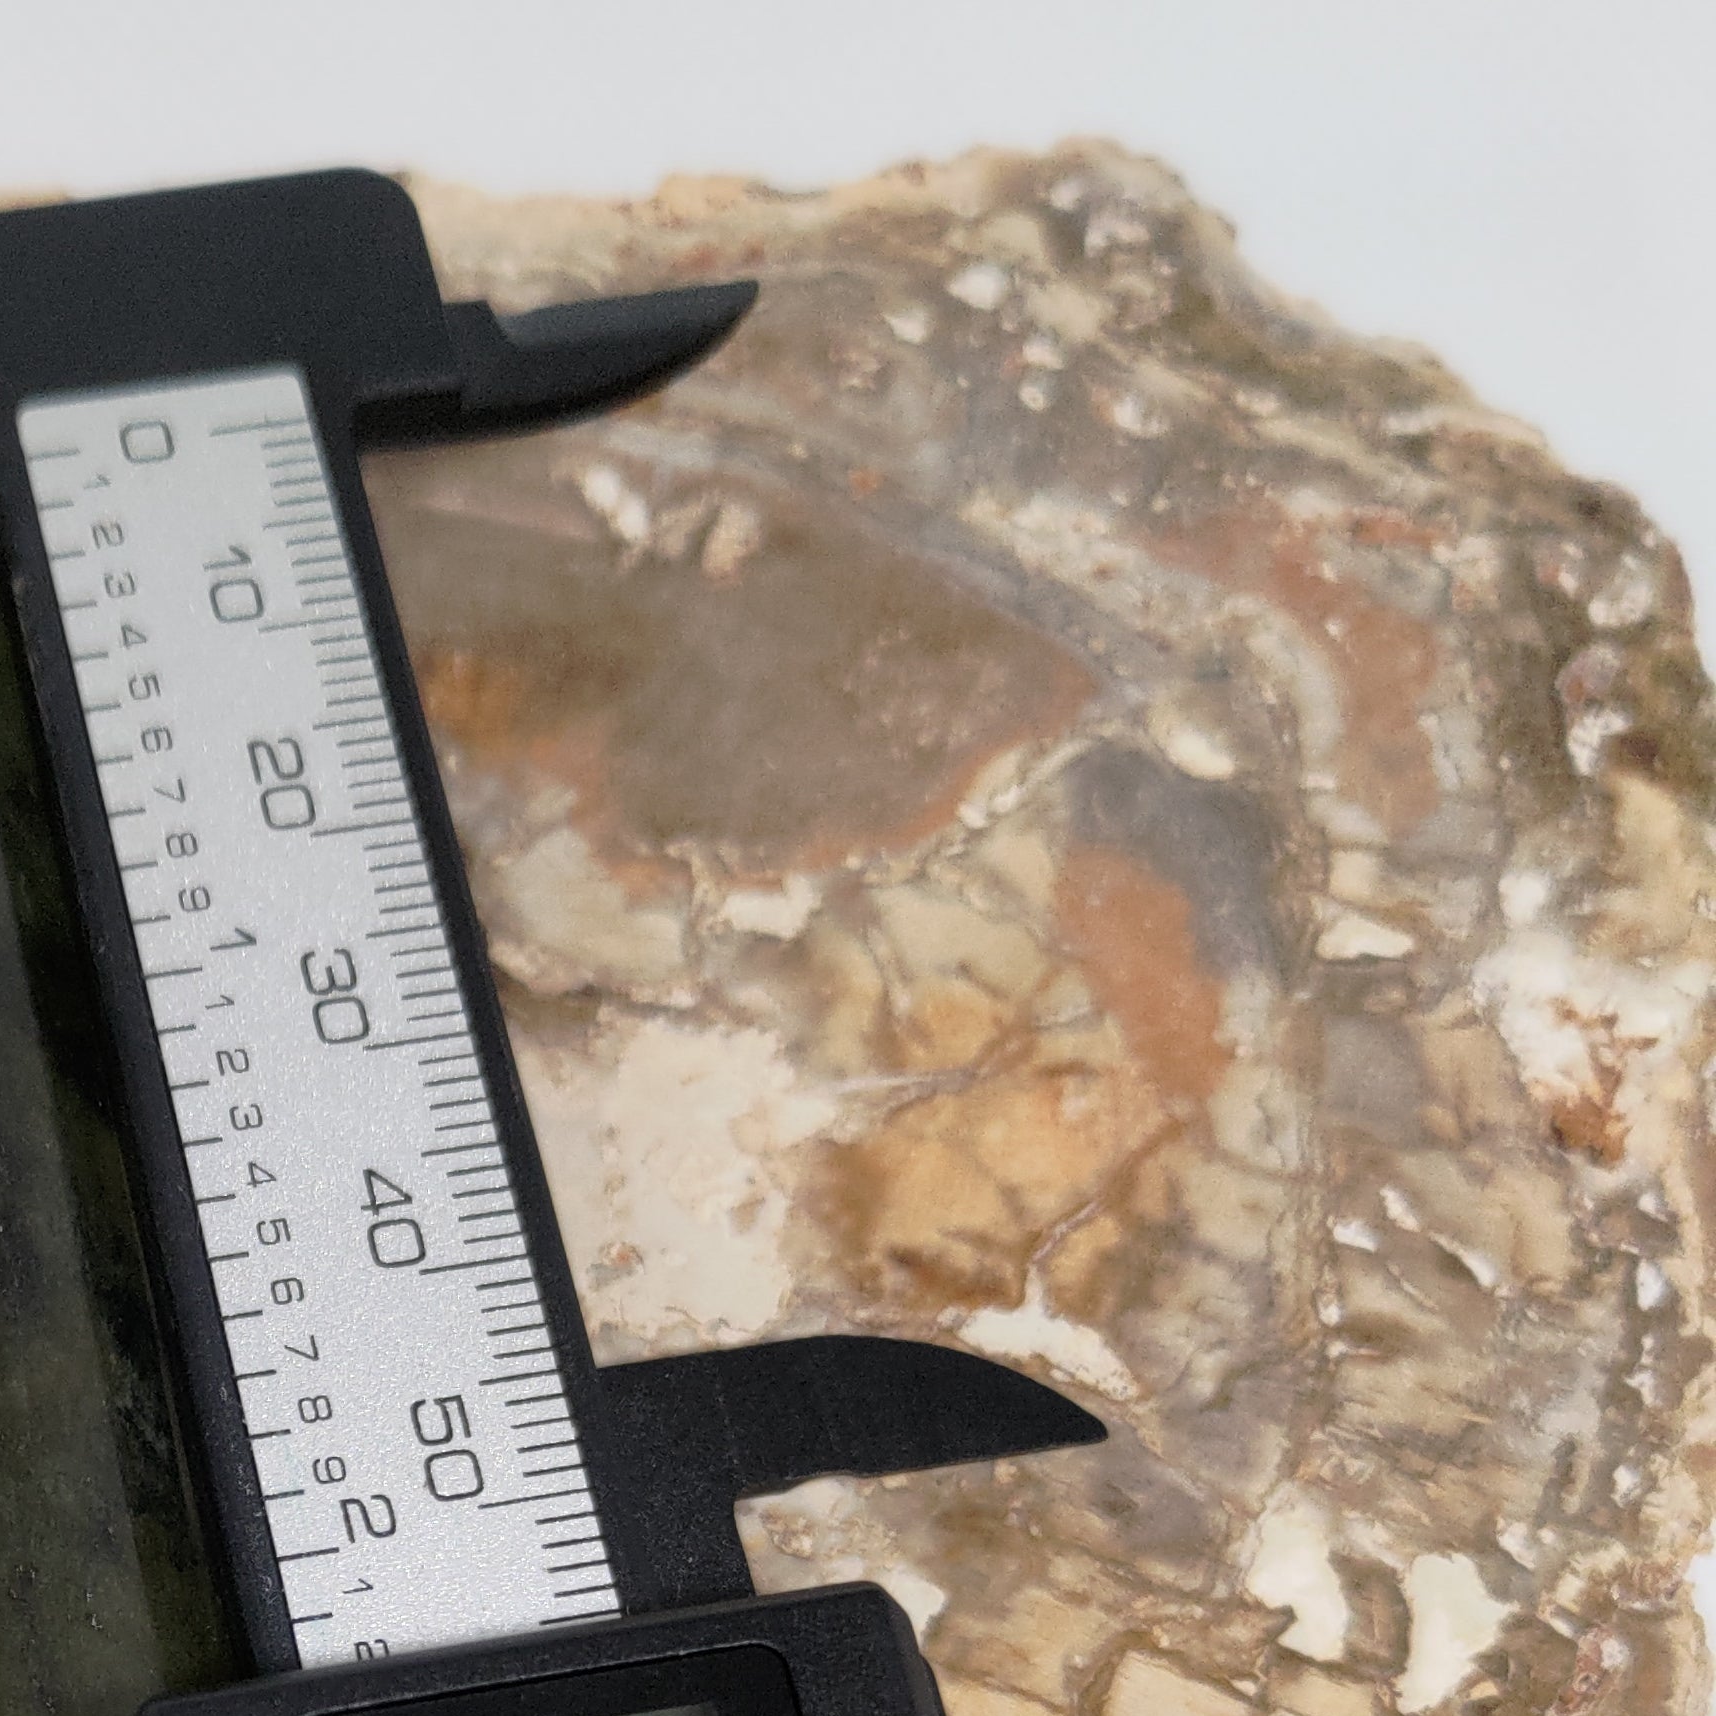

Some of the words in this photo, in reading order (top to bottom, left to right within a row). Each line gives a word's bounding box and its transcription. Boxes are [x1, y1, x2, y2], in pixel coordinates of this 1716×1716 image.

[84, 473, 111, 489] 1
[91, 521, 124, 549] 2
[103, 571, 135, 599] 3
[120, 624, 147, 650] 4
[127, 671, 161, 700] 5
[141, 725, 173, 753] 6
[153, 778, 185, 803] 7
[165, 832, 198, 859] 8
[178, 886, 211, 912] 9
[210, 927, 257, 951] 1
[119, 420, 175, 465] 0
[202, 544, 265, 623] 10
[247, 737, 316, 831] 20
[300, 948, 369, 1045] 30
[360, 1168, 425, 1268] 40
[410, 1394, 484, 1501] 50
[205, 994, 235, 1010] 1
[216, 1048, 250, 1076] 2
[229, 1103, 263, 1131] 3
[247, 1161, 277, 1188] 4
[256, 1217, 291, 1246] 5
[270, 1276, 304, 1306] 6
[284, 1334, 320, 1362] 7
[297, 1394, 332, 1424] 8
[312, 1455, 347, 1486] 9
[339, 1494, 397, 1544] 2
[343, 1577, 374, 1595] 1
